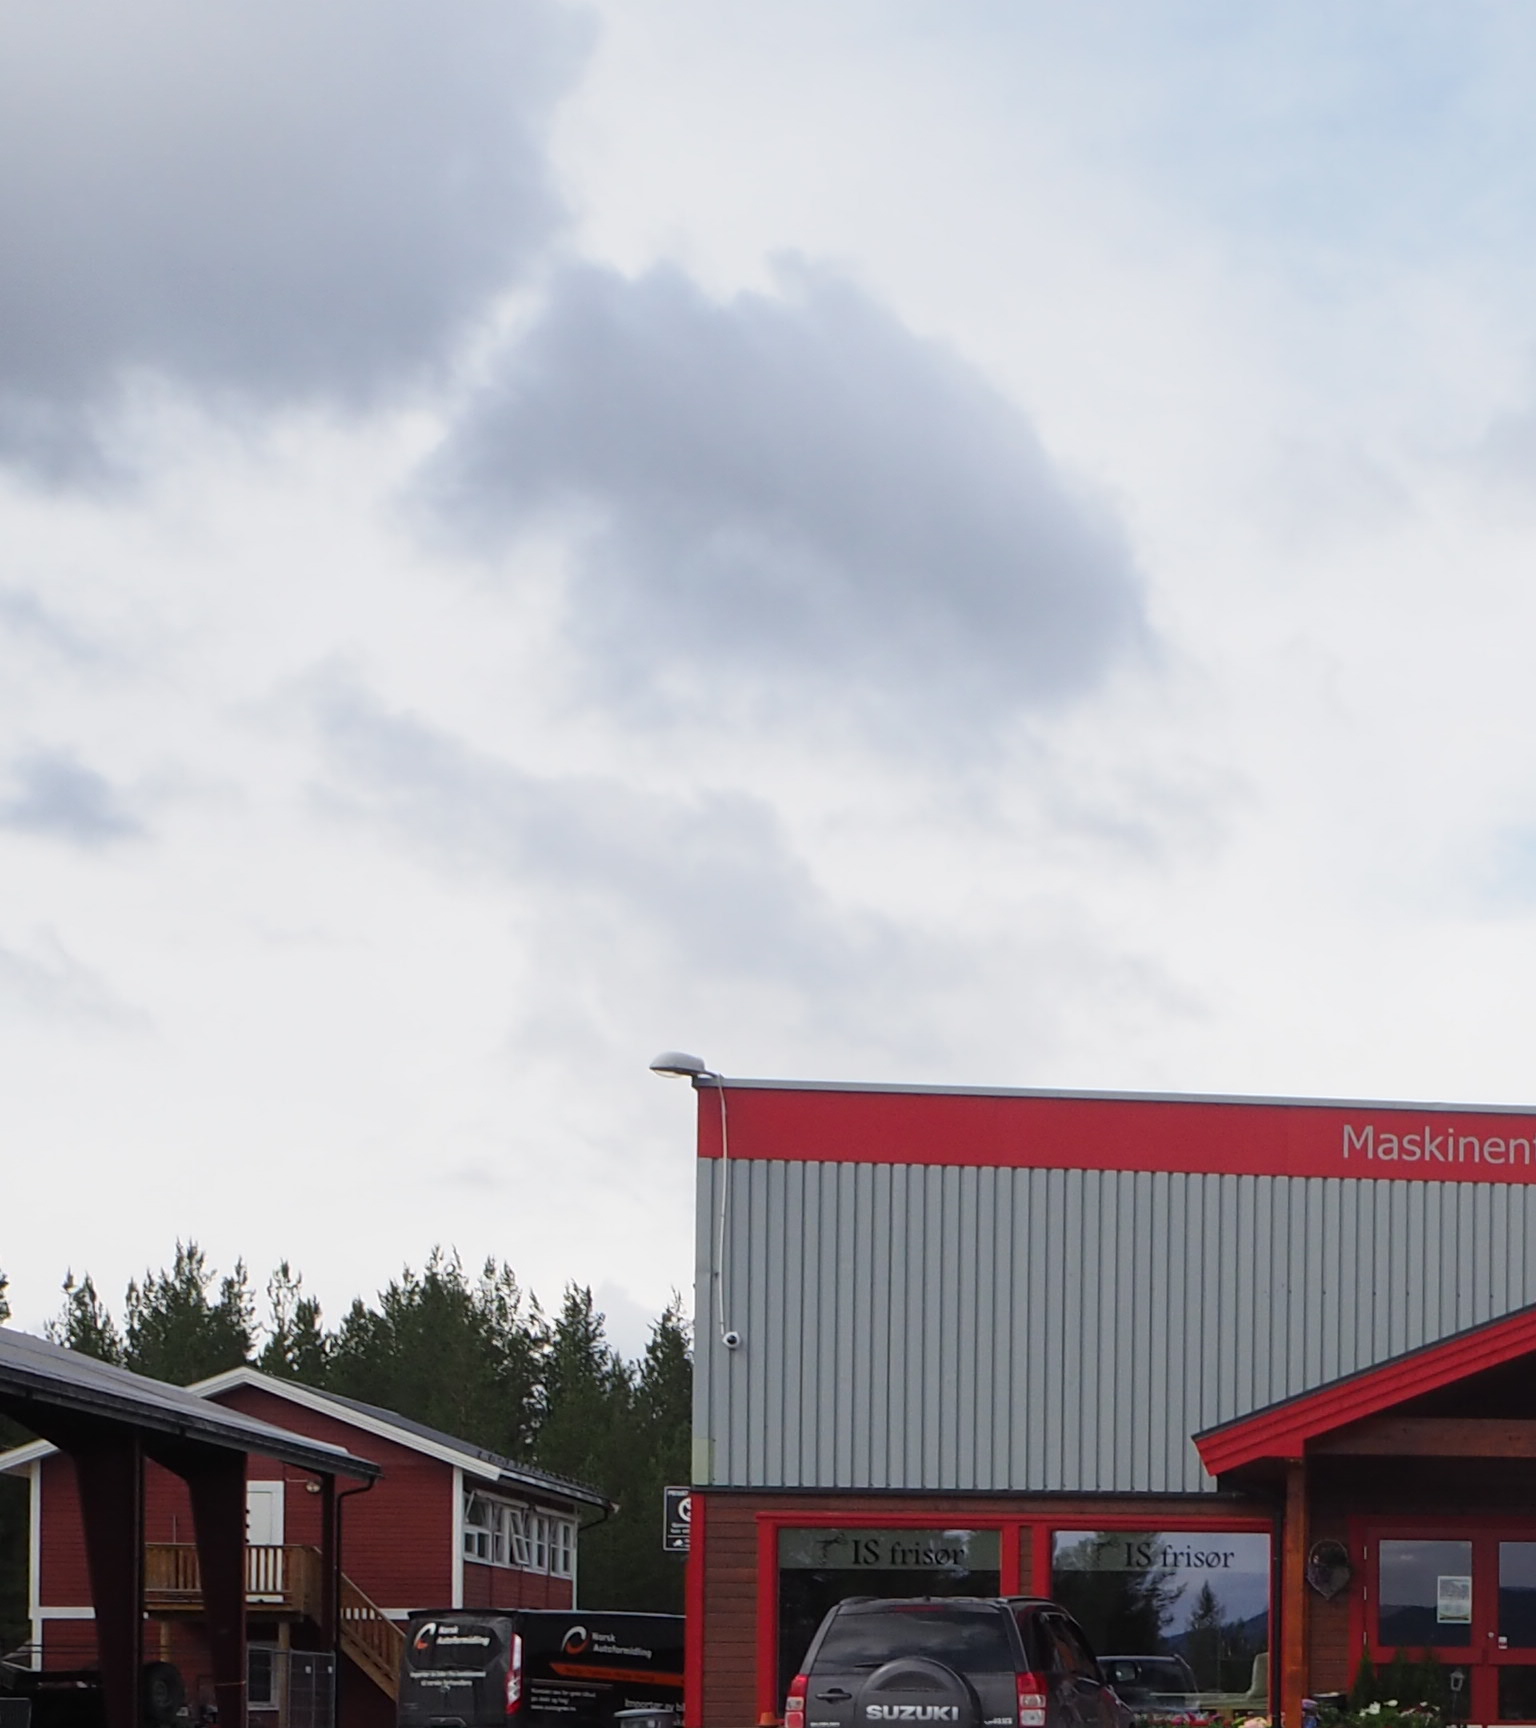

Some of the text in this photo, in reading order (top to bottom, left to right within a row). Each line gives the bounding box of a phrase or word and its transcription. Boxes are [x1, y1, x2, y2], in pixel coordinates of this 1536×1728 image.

[852, 1539, 965, 1567] IS frisør
[1124, 1542, 1235, 1569] IS frisør
[865, 1704, 960, 1721] SUZUKI
